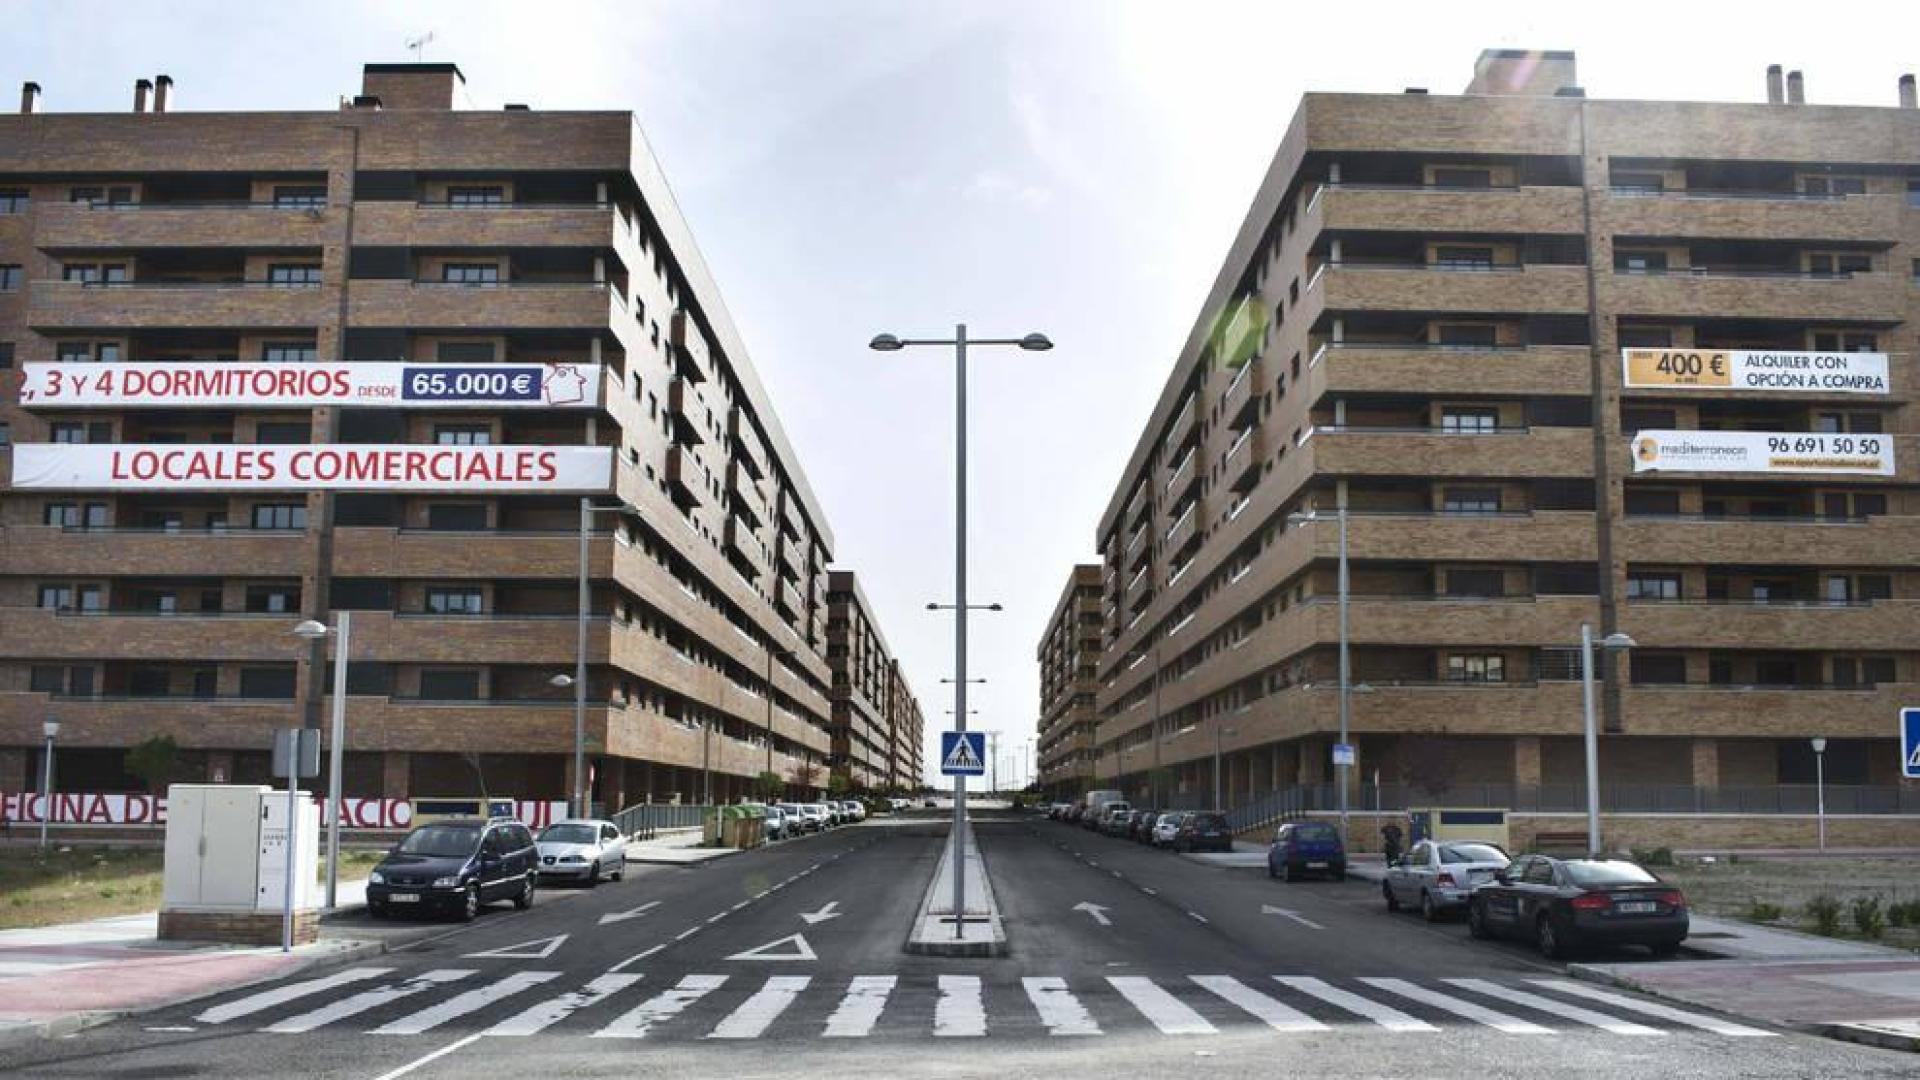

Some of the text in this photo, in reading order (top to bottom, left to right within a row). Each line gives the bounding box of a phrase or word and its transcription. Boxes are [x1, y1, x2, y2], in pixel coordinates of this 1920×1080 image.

[1656, 352, 1725, 377] 400 €
[1745, 354, 1847, 369] ALQUILER CON
[44, 369, 63, 397] 3
[71, 375, 88, 396] Y
[94, 369, 114, 396] 4
[121, 369, 351, 398] DORMITORIOS
[357, 385, 397, 398] DESDE
[1746, 370, 1884, 389] OPCIÓN A COMPRA
[1768, 437, 1880, 455] 96 691 50 50
[111, 450, 558, 482] LOCALES COMERCIALES
